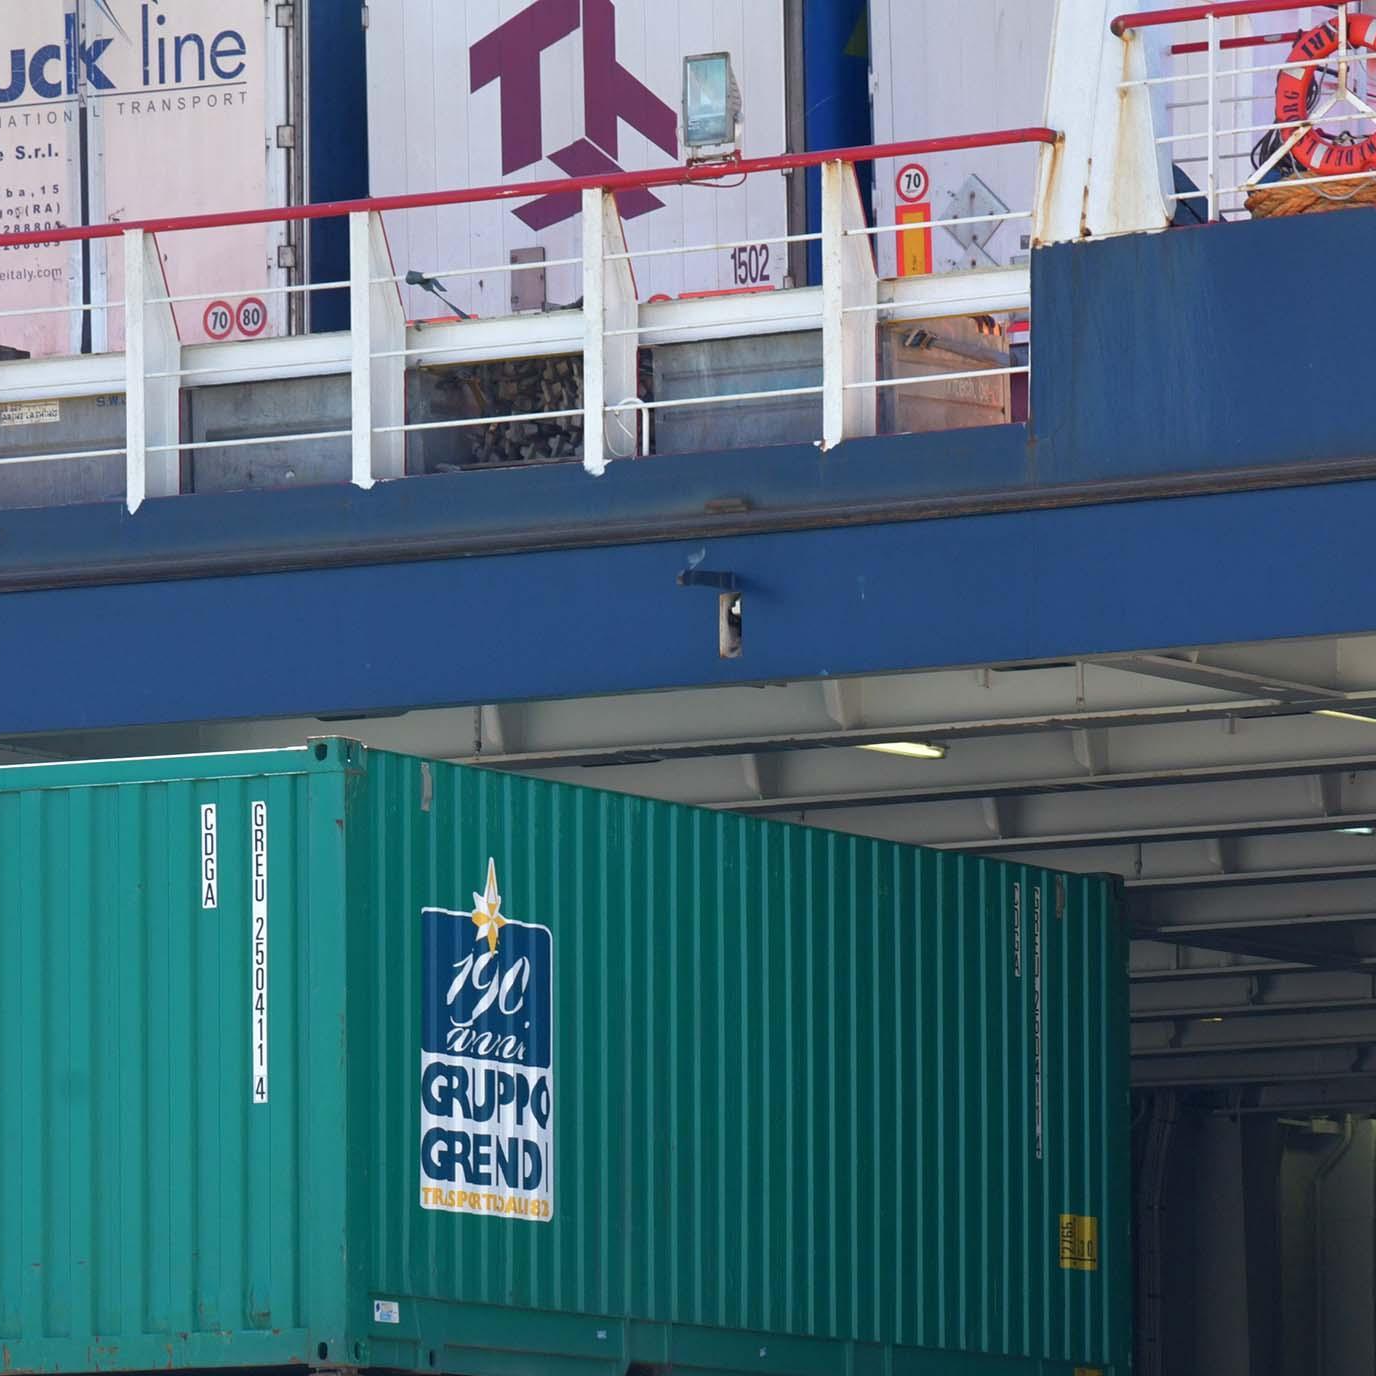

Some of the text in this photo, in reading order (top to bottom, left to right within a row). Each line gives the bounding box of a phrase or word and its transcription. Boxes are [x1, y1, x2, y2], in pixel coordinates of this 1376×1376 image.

[142, 4, 247, 86] line
[117, 92, 248, 116] TRANSPORT
[15, 143, 59, 160] S.r.l.
[905, 172, 922, 190] 70
[24, 203, 61, 216] (RA)
[730, 243, 770, 285] 1502
[211, 307, 261, 331] 70 80
[203, 806, 216, 907] CDGA
[254, 803, 266, 1100] GREU 250411 4
[446, 946, 531, 1028] 190
[445, 1021, 531, 1061] anni
[421, 1061, 551, 1130] GRUPPO
[421, 1126, 550, 1193] GRENDI
